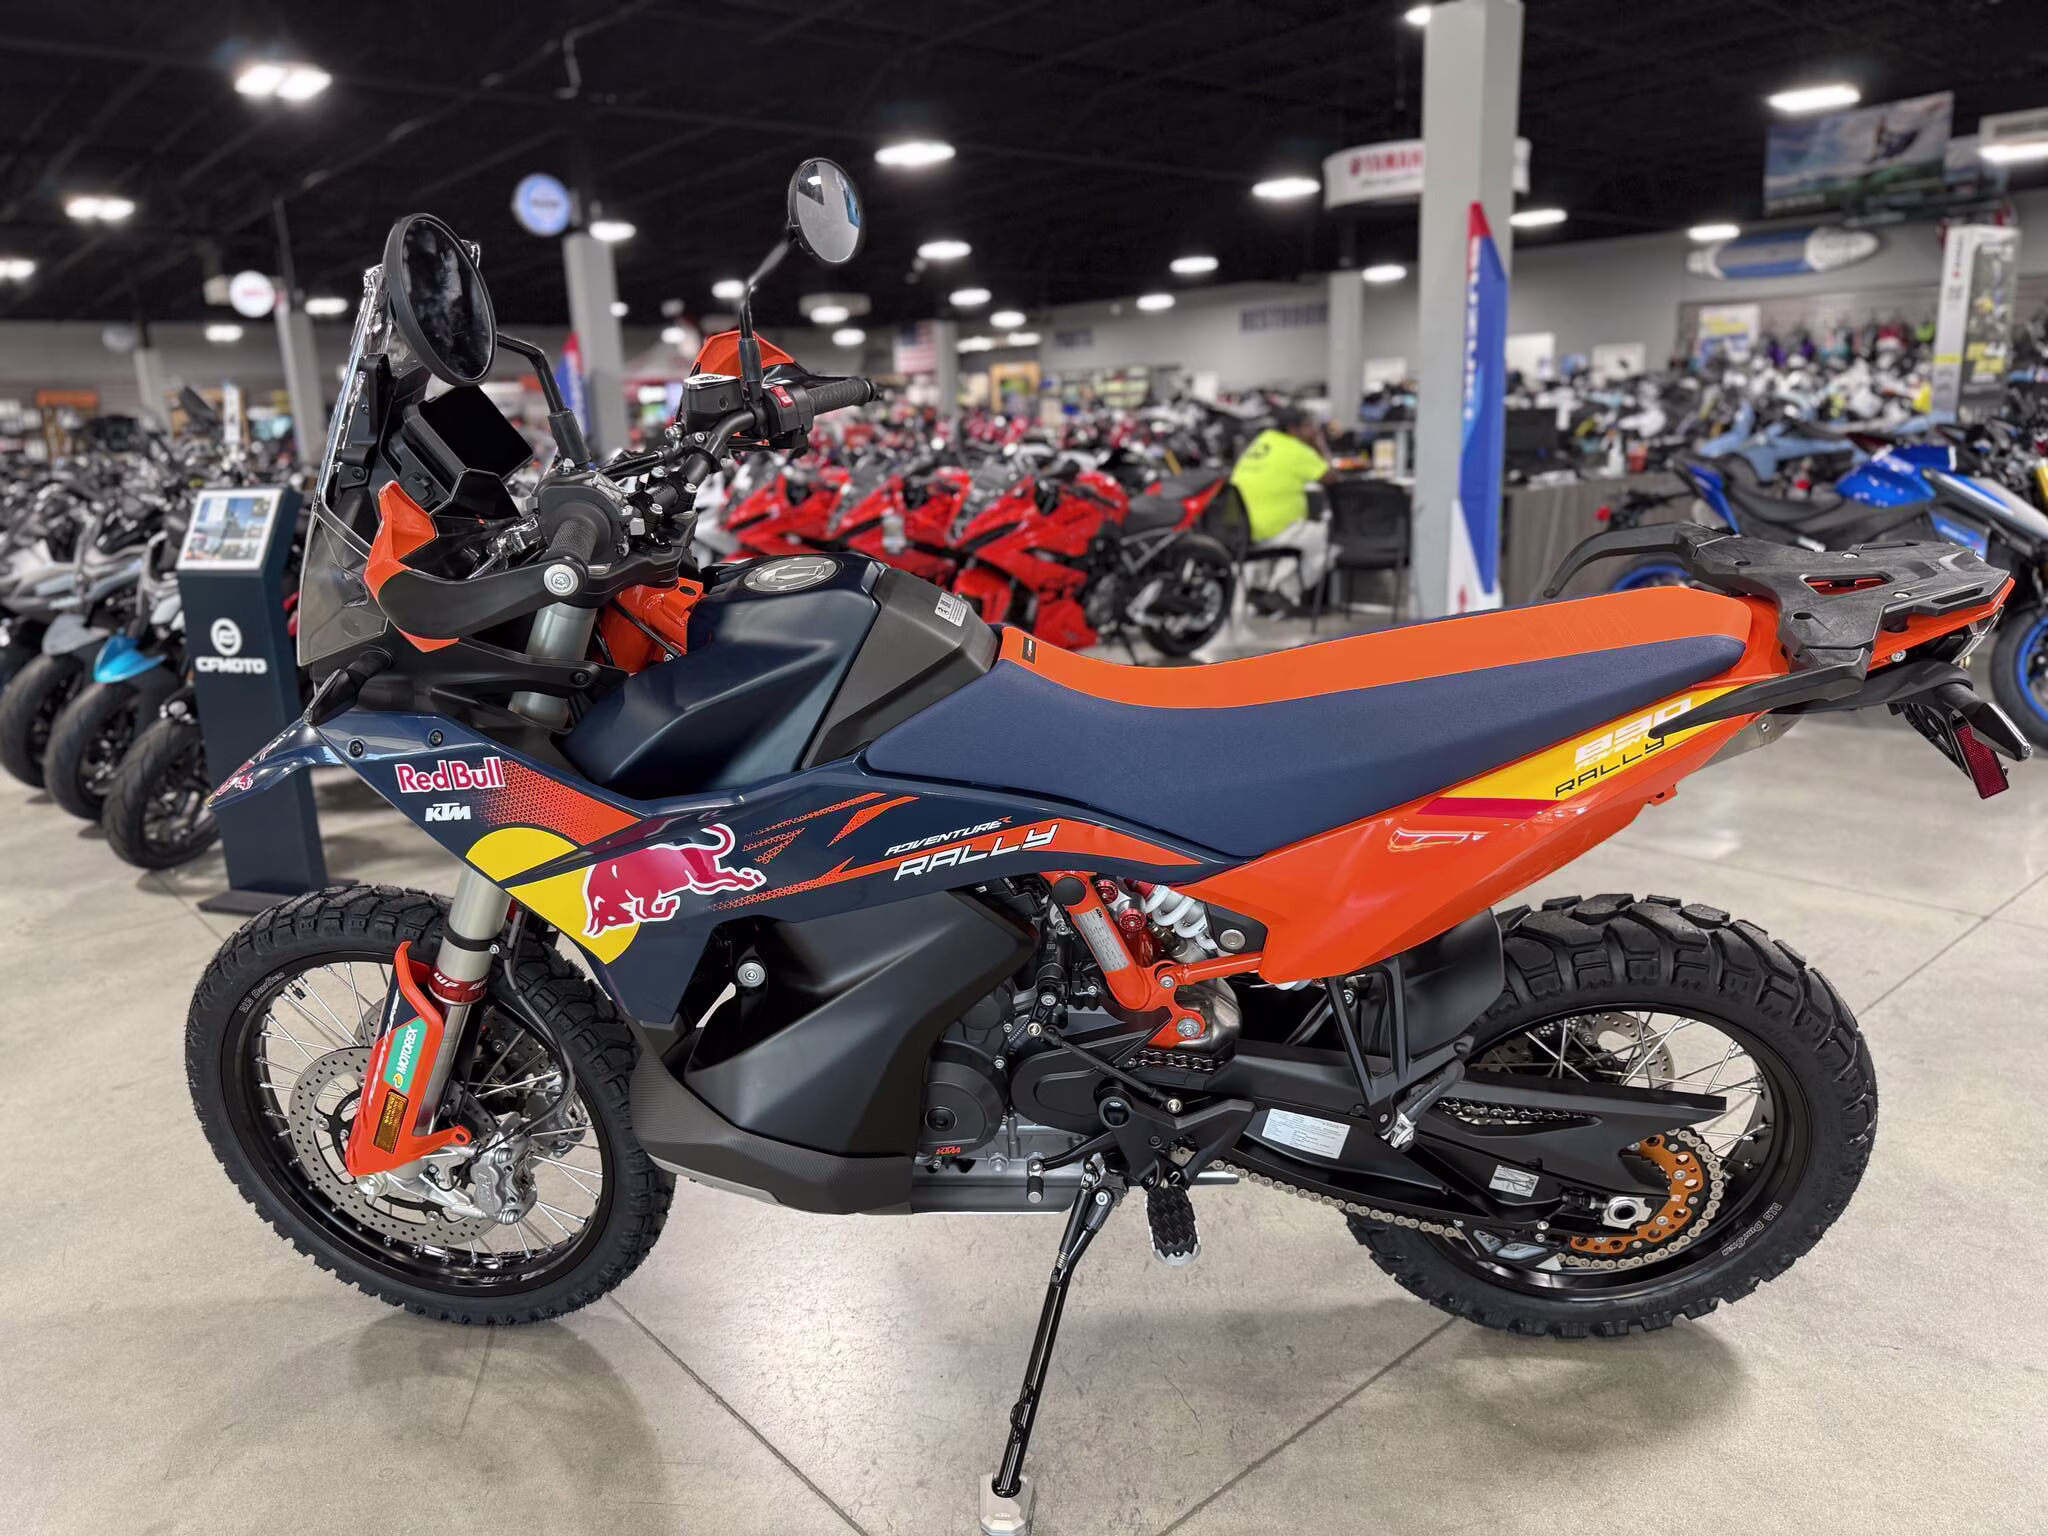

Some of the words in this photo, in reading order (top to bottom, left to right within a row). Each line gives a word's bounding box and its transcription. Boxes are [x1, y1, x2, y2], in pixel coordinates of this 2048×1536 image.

[195, 656, 267, 675] CFMOTO
[395, 763, 453, 793] Red
[448, 756, 506, 790] Bull
[1555, 735, 1665, 797] RALLY
[425, 803, 471, 821] KTM
[884, 820, 1001, 857] ADVENTURE
[893, 823, 1060, 881] RALLY
[433, 971, 460, 988] WP
[396, 1025, 418, 1075] MOTOREX
